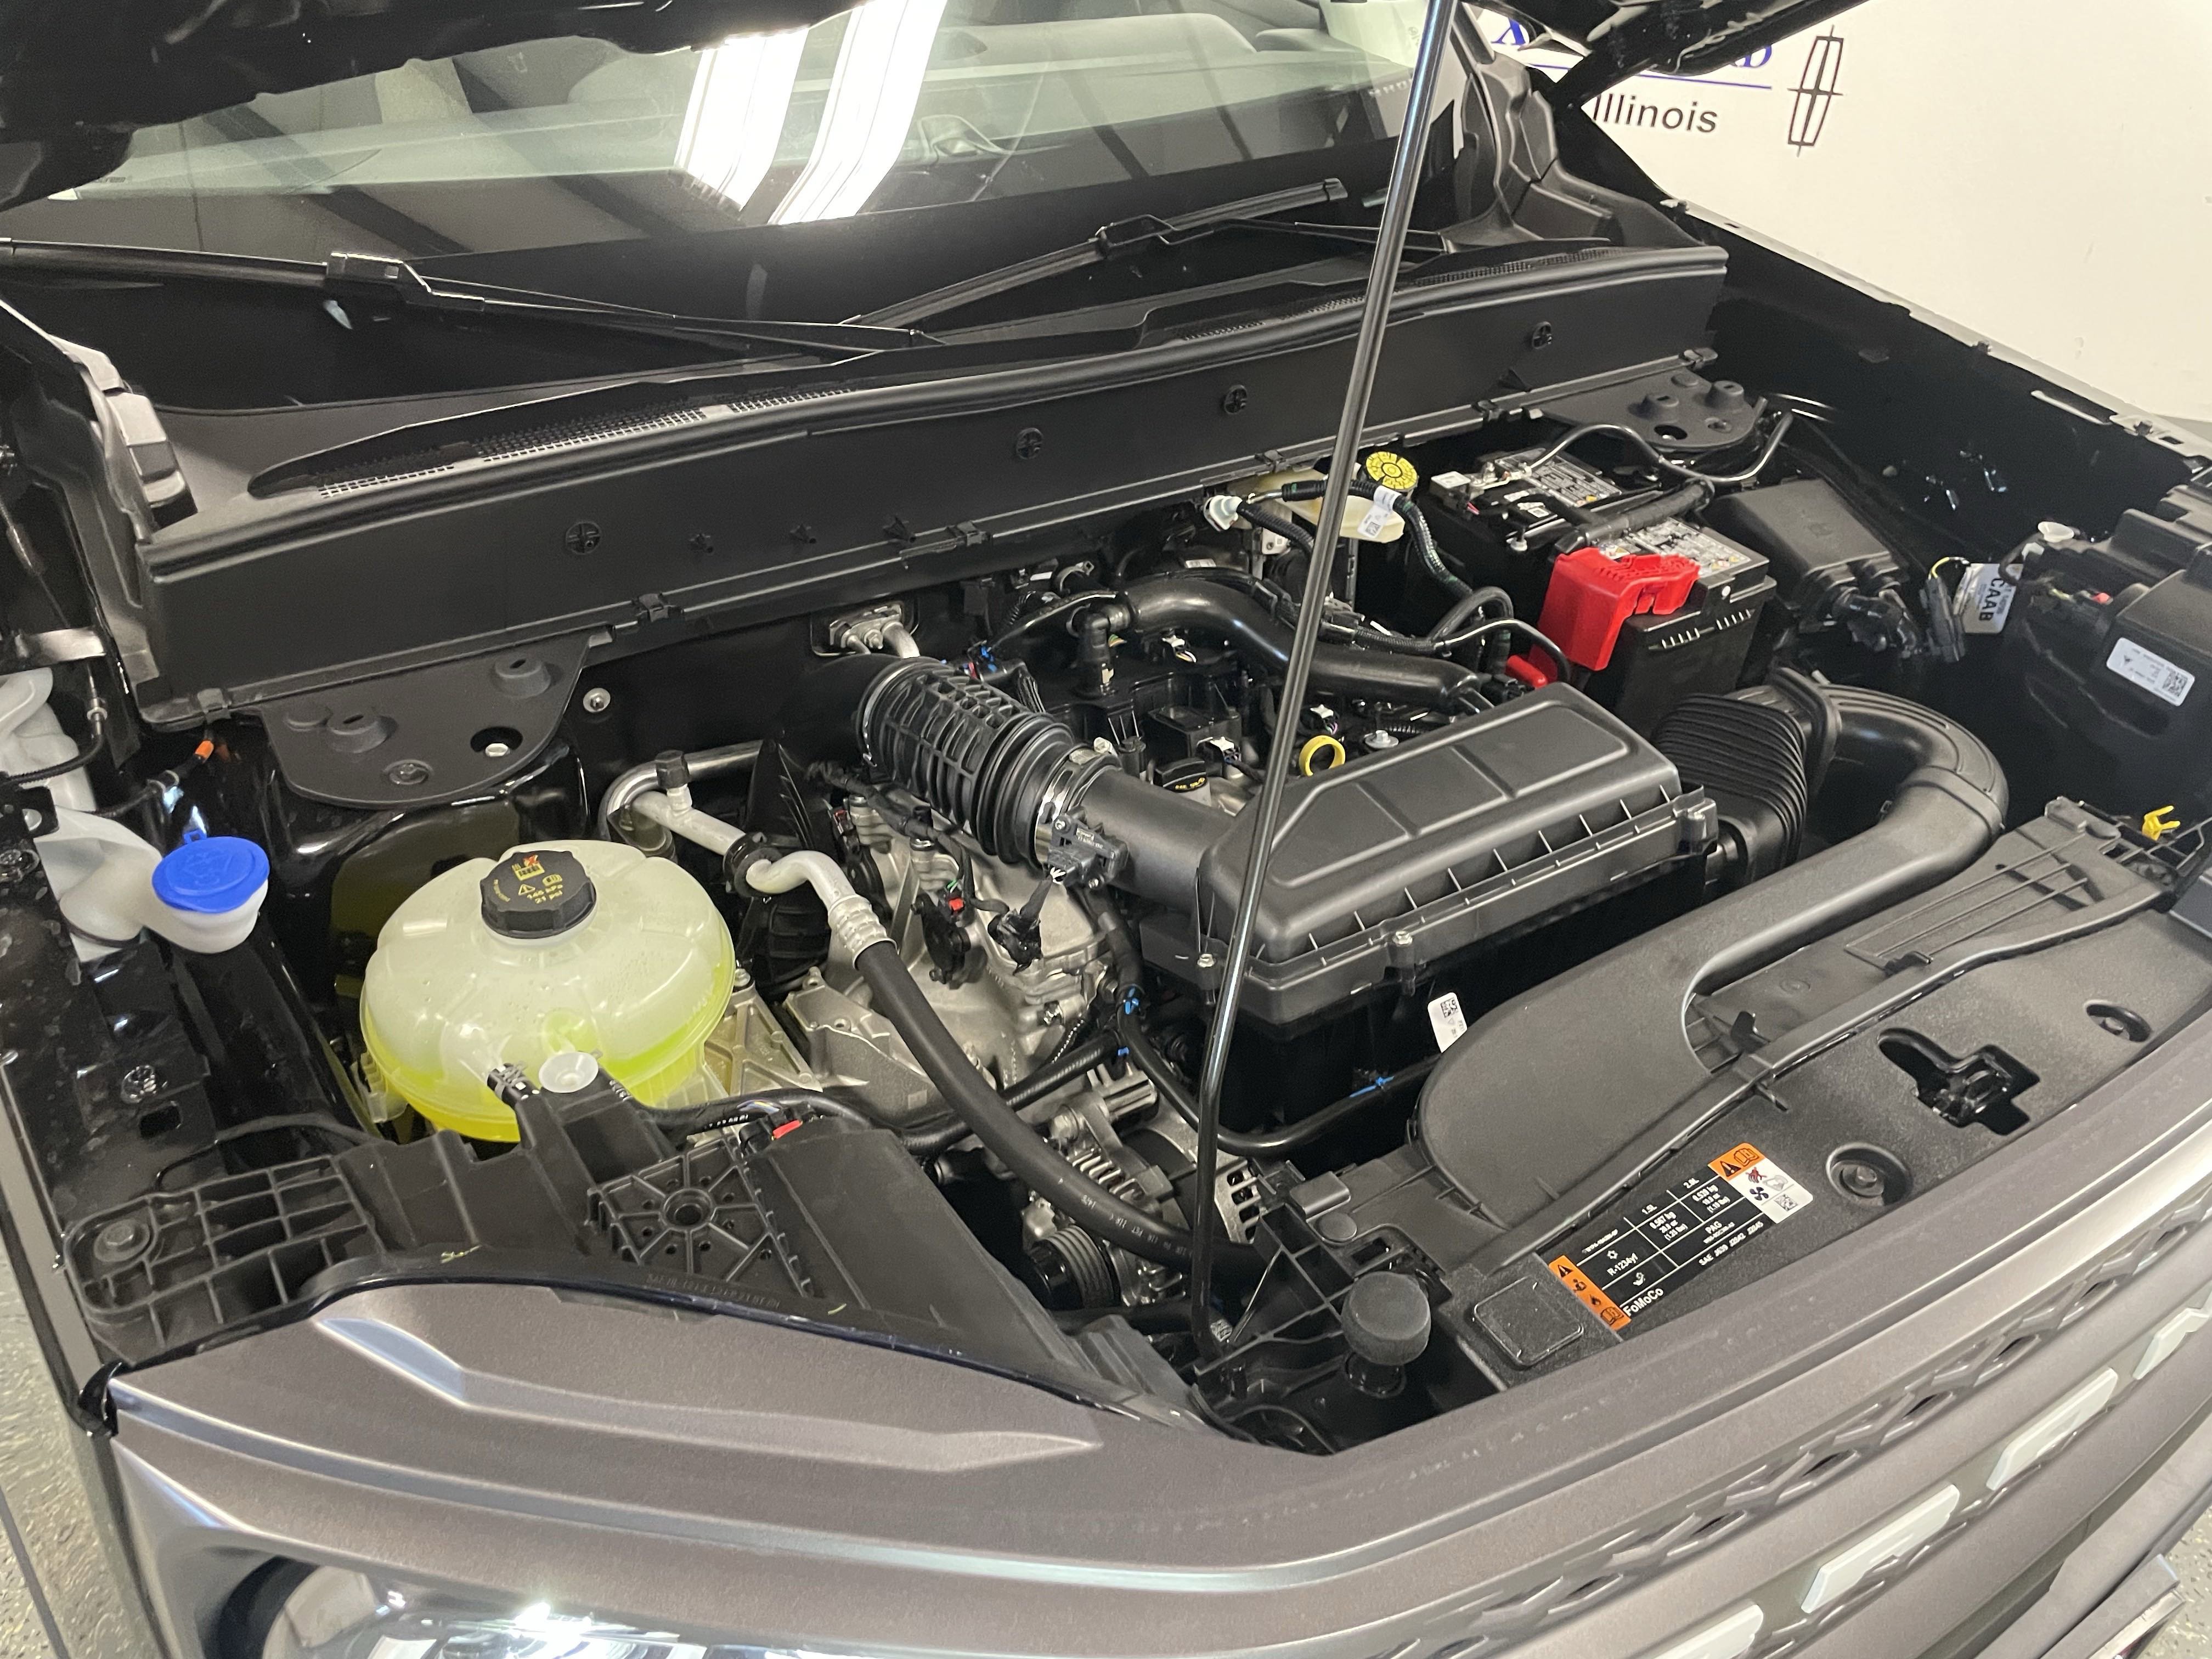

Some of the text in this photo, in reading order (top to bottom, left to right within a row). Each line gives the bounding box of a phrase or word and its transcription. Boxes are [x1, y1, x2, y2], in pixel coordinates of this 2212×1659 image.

[1592, 93, 1718, 133] Illinois
[1705, 1221, 1722, 1234] PAG
[1606, 1252, 1638, 1276] R-1234yf
[1699, 1253, 1714, 1266] SAE
[1622, 1288, 1664, 1317] FoMoCo
